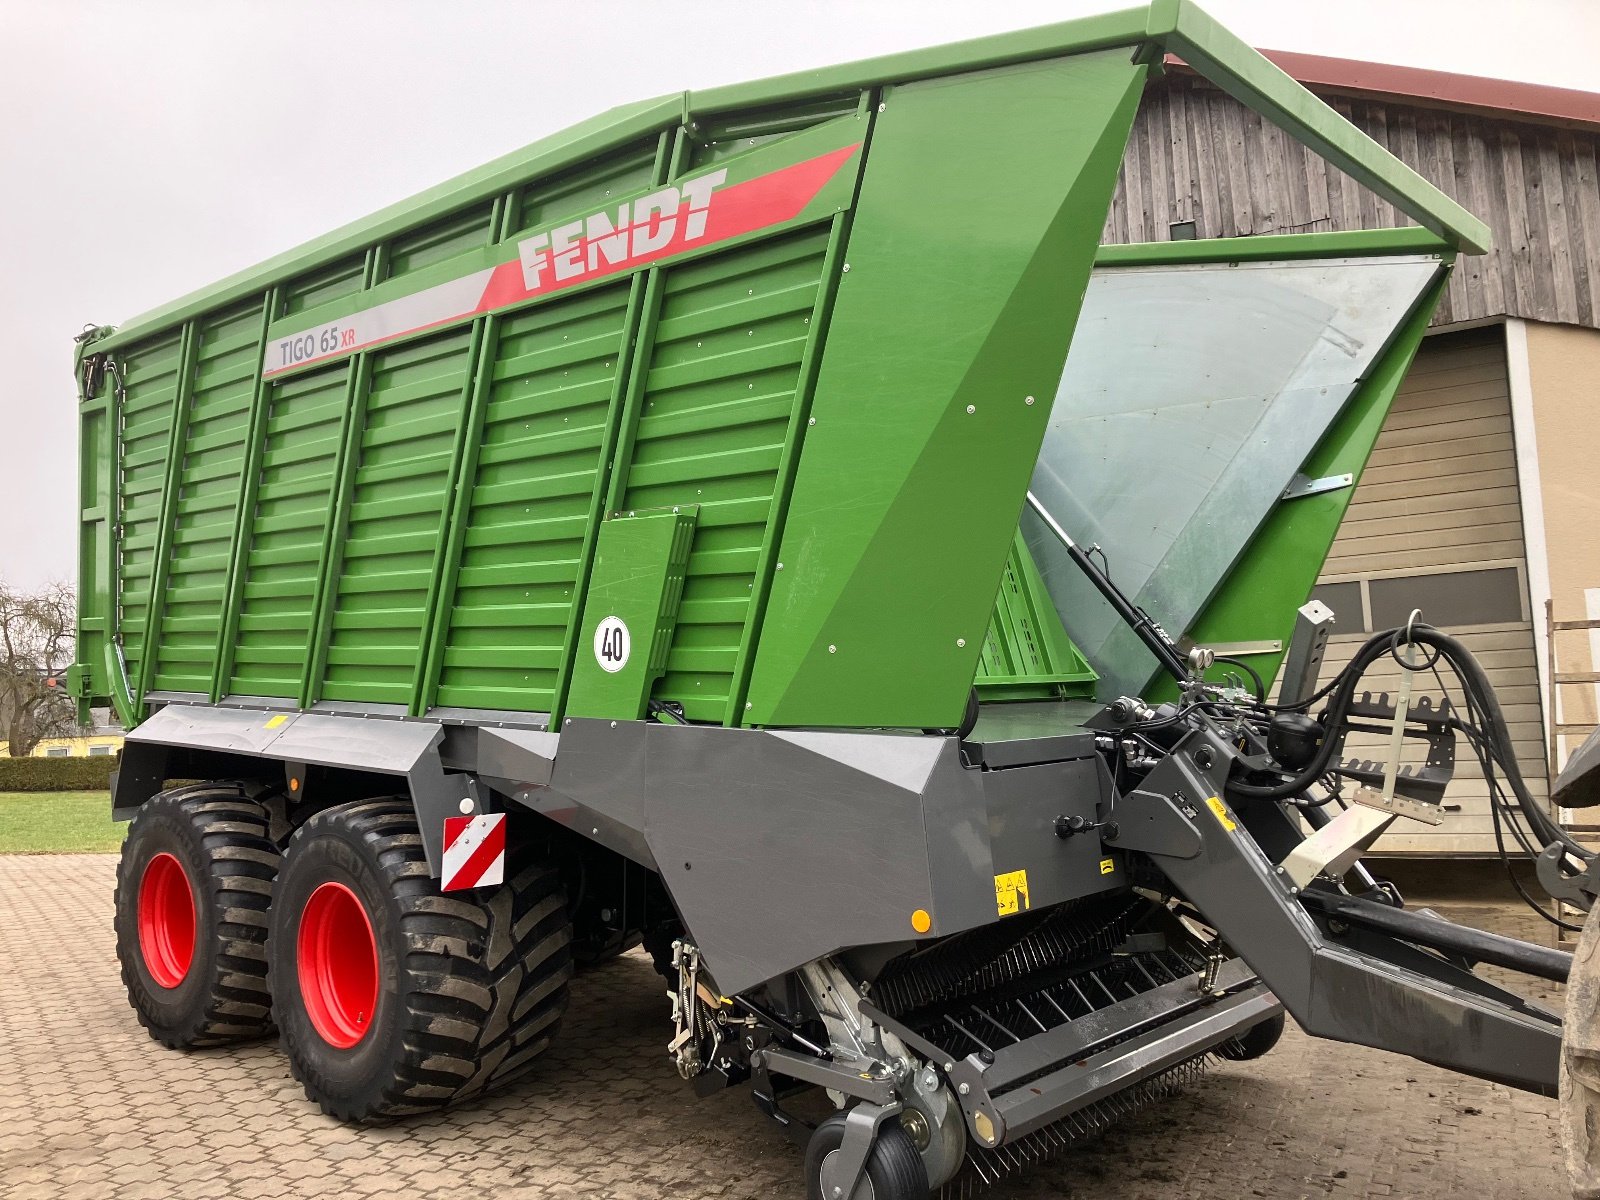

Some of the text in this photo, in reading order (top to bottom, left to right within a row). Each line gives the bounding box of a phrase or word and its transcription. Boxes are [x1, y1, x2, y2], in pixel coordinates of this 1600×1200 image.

[519, 169, 727, 291] FENDT
[281, 327, 355, 365] TIGO 65 XR
[602, 627, 623, 661] 40
